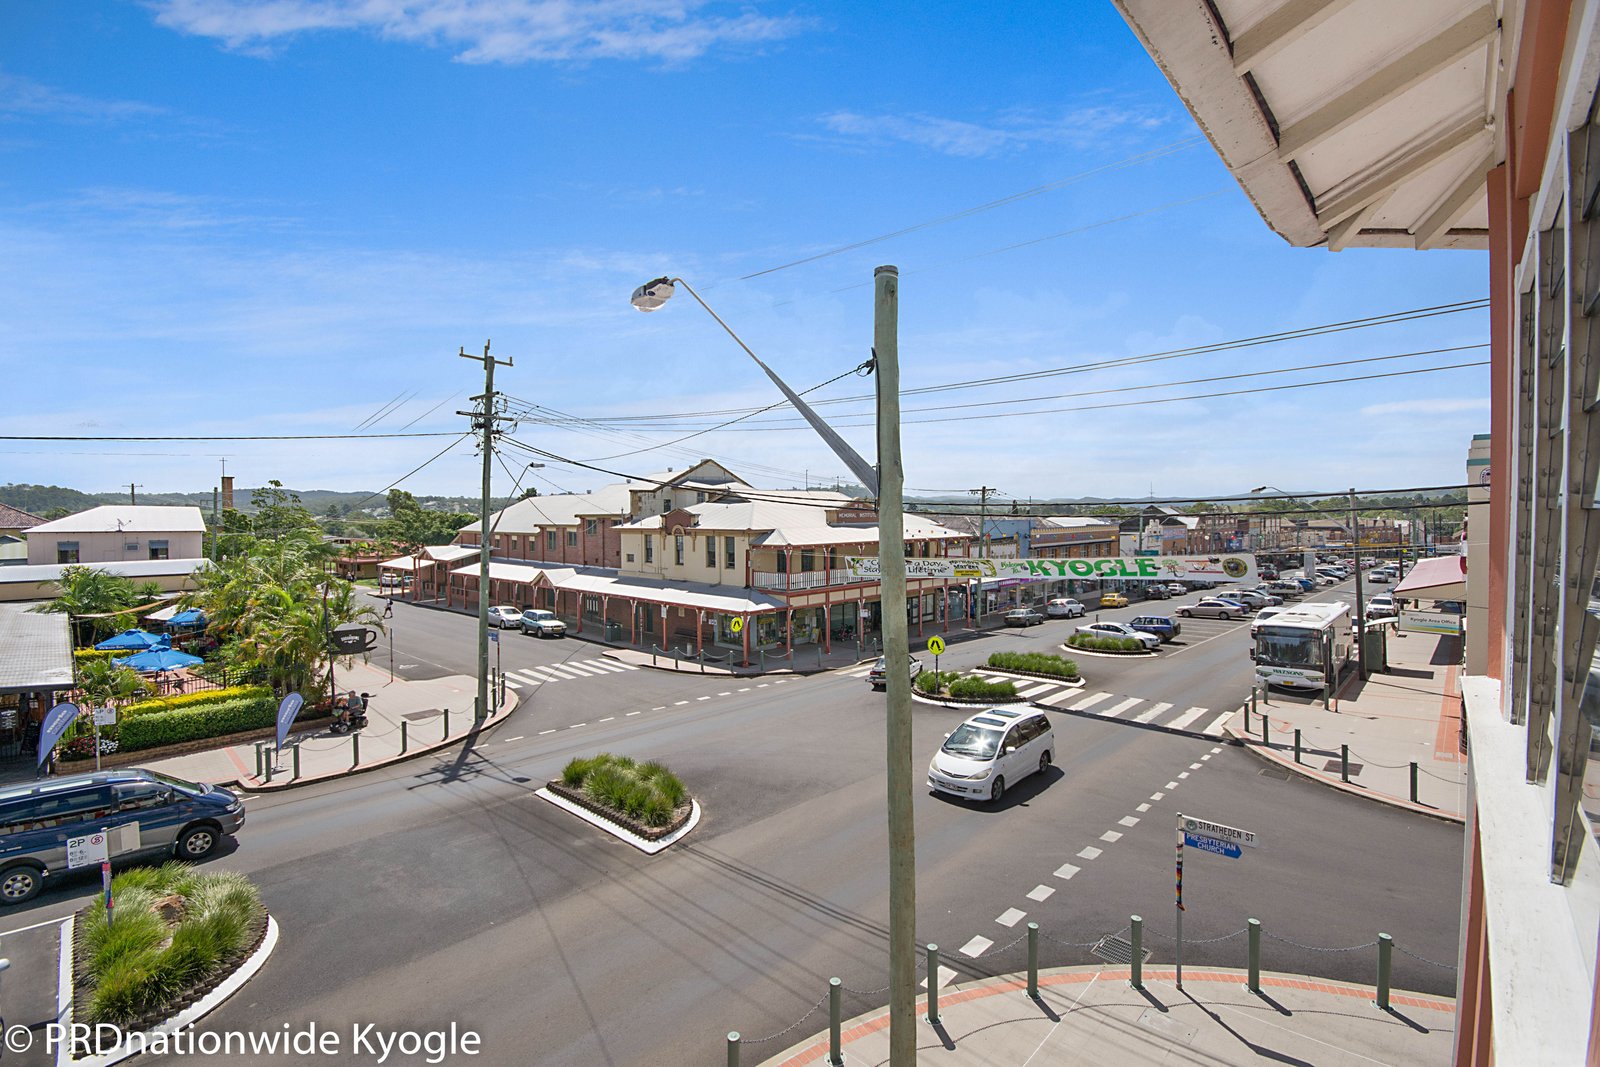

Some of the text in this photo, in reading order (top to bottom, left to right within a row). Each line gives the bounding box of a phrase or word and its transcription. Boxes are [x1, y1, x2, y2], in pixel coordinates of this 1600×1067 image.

[1026, 557, 1159, 577] KYOGLE
[1198, 821, 1242, 839] STRATHEDEN
[1245, 832, 1255, 842] ST
[69, 838, 86, 848] 2P
[1186, 833, 1237, 851] PRESBYTERIAN
[1197, 842, 1225, 854] CHURCH
